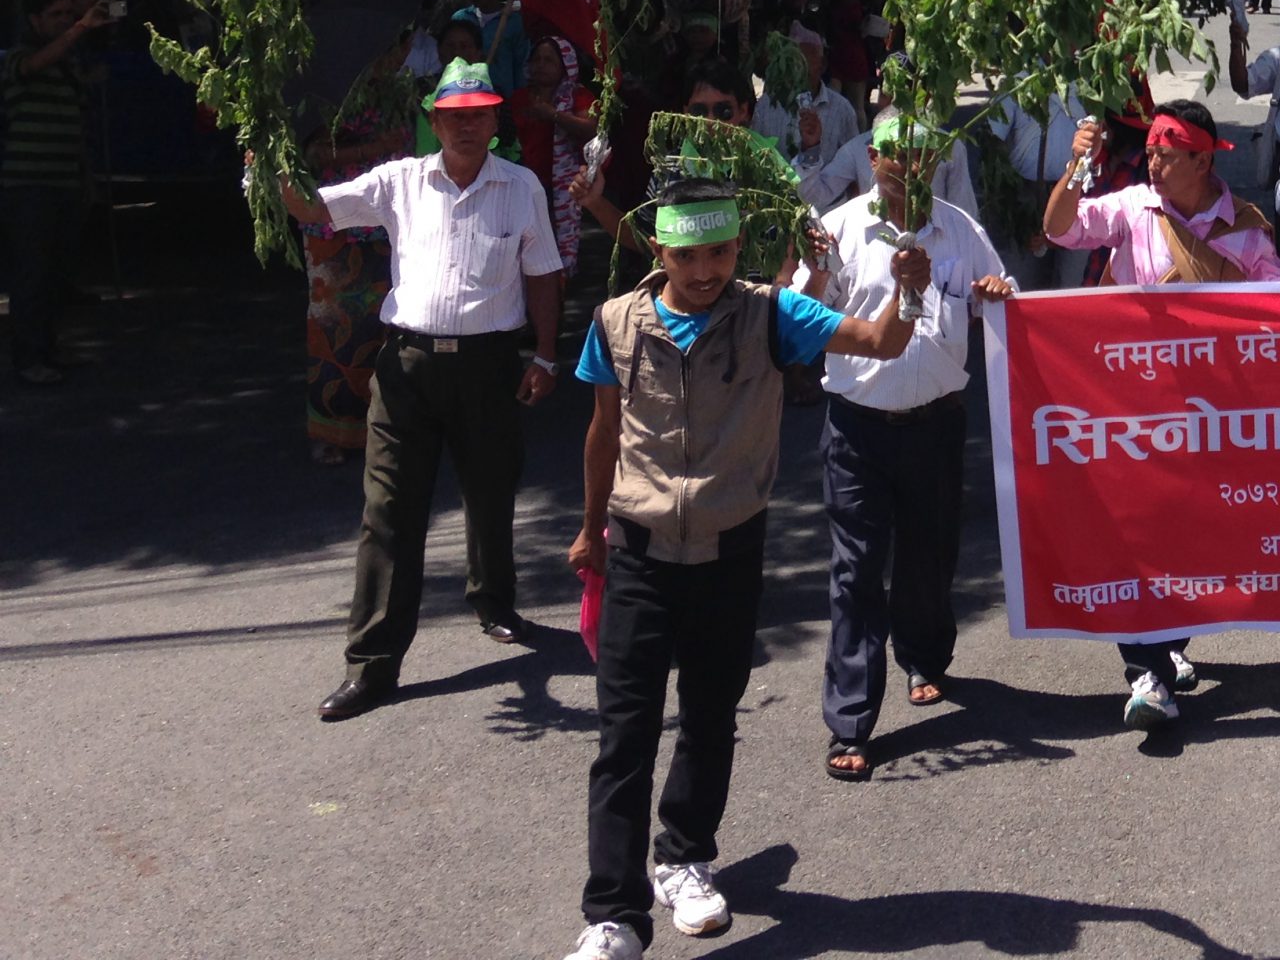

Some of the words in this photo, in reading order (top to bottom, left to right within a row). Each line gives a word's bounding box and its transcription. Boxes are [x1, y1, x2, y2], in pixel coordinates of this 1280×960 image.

[676, 210, 726, 238] तमुवान
[1219, 483, 1279, 505] २०७२
[1053, 580, 1139, 612] तमुवान
[1148, 573, 1227, 601] संयुक्त
